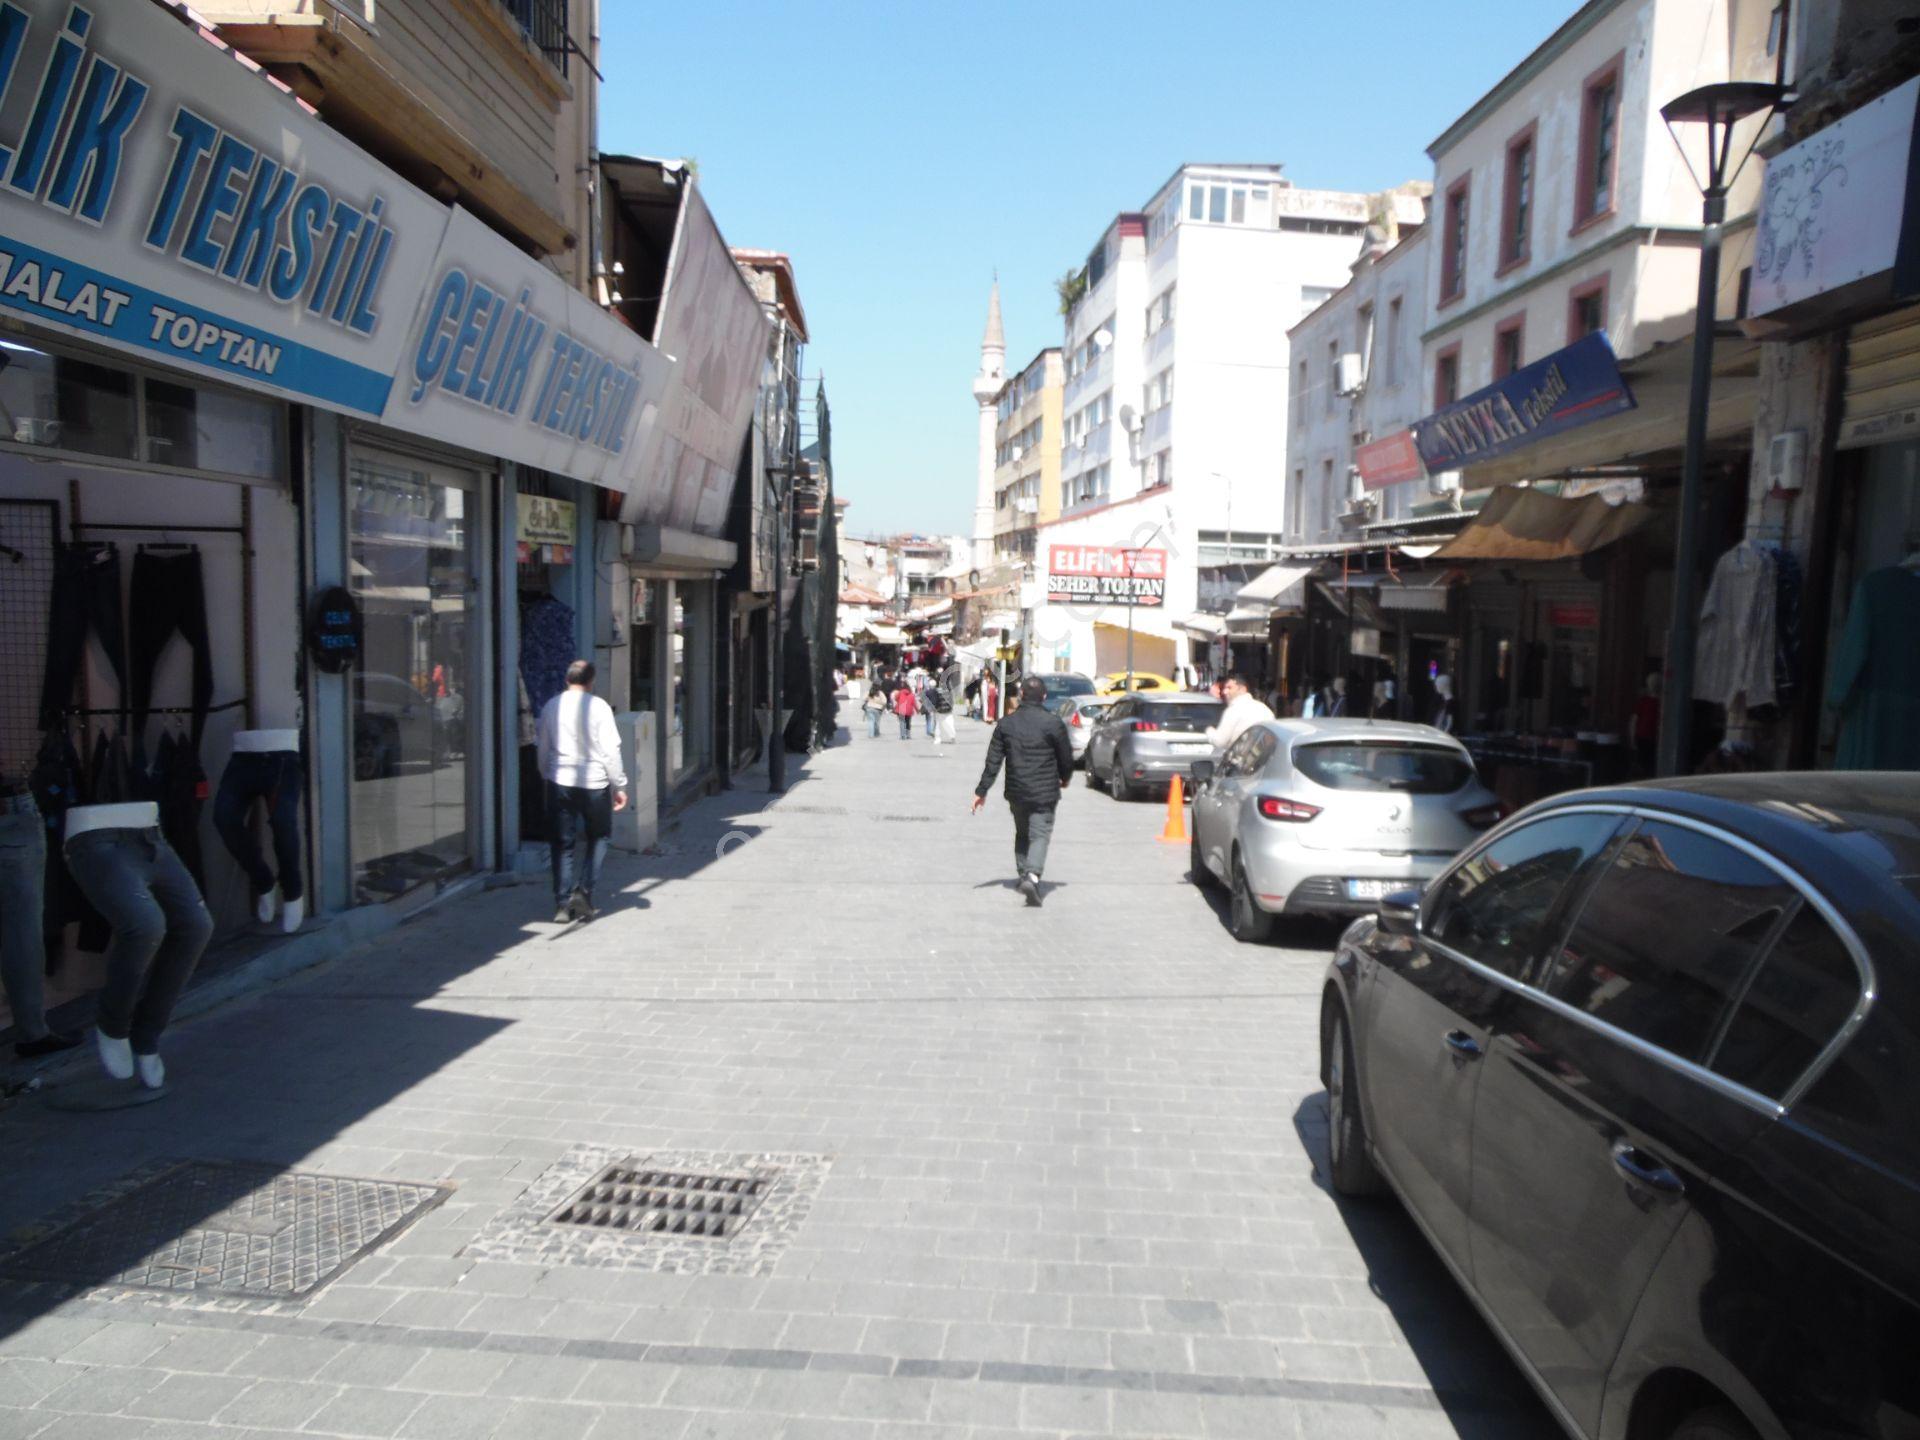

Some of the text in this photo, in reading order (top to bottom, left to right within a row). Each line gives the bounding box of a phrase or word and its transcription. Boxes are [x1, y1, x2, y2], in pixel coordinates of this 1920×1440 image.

[142, 103, 396, 338] TEKSTİL
[149, 304, 283, 376] TOPTAN
[409, 267, 643, 456] ÇELİK TEKSTİL
[1047, 575, 1100, 593] SEHER
[1054, 546, 1124, 573] ELİFİM
